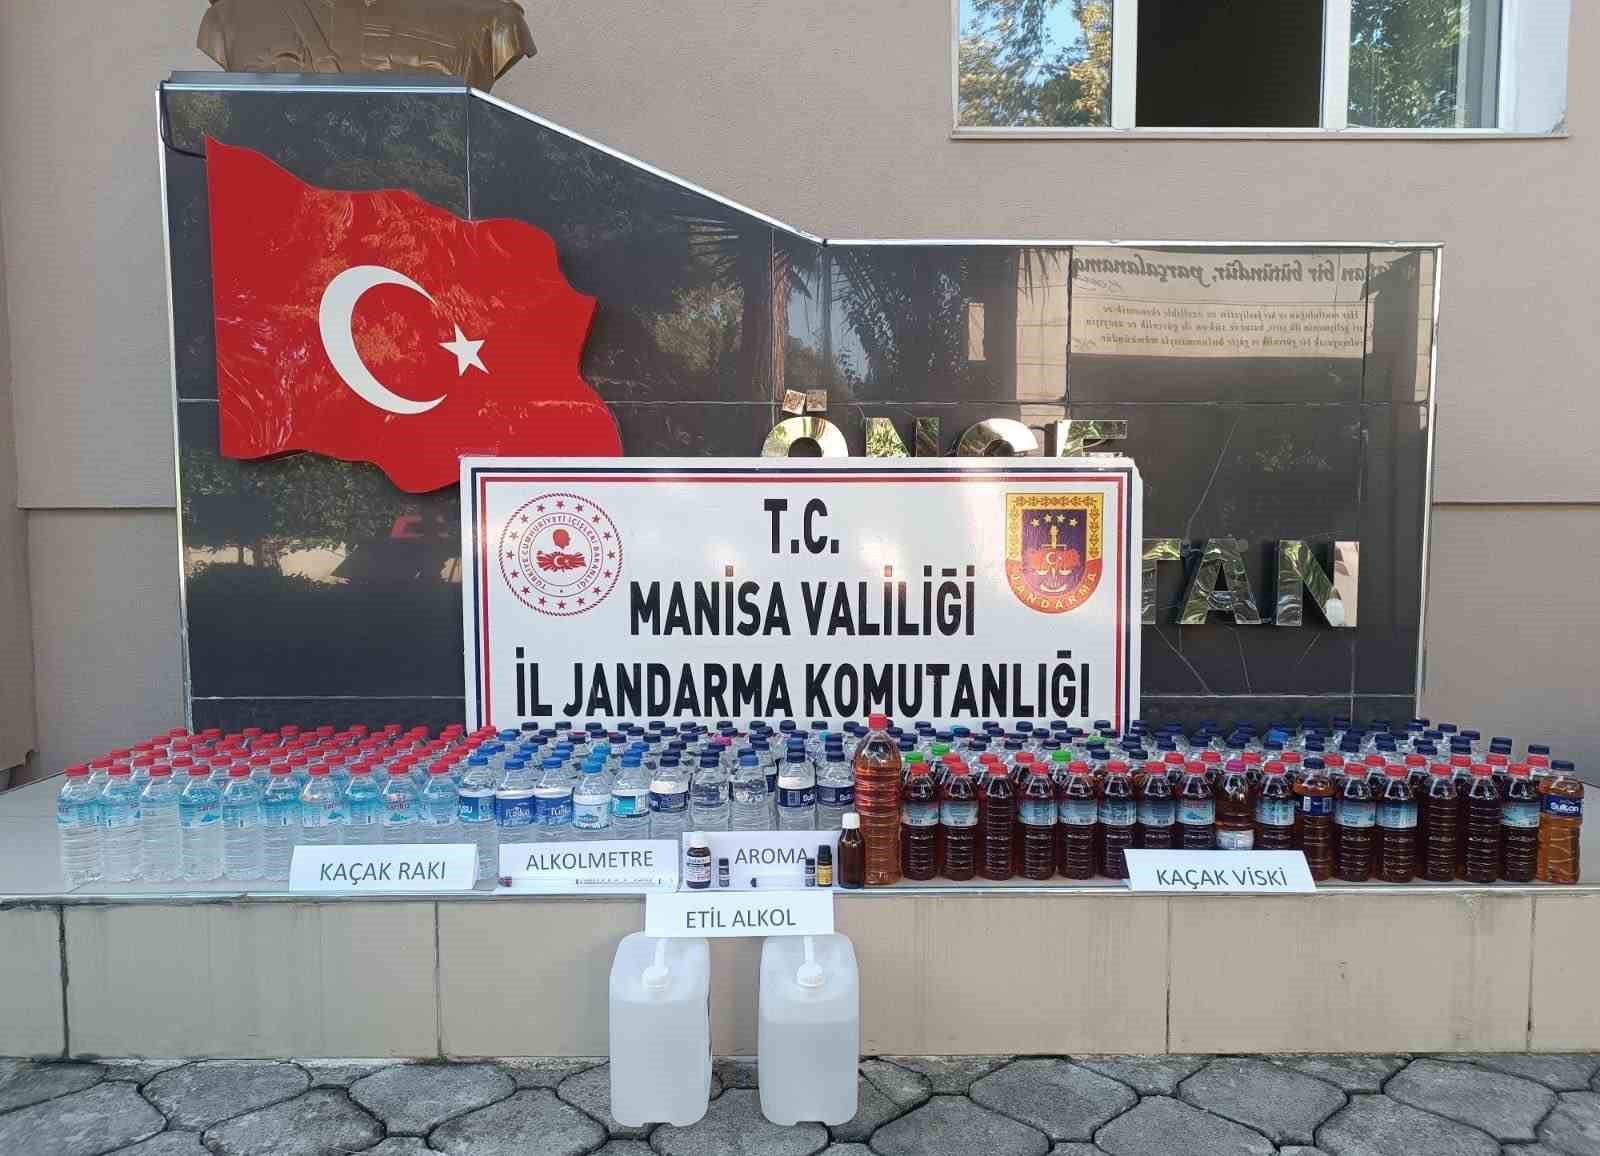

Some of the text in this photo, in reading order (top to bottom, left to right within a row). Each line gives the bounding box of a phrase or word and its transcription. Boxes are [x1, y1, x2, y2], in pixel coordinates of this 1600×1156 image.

[764, 498, 840, 555] T.C.
[631, 565, 975, 637] MANİSA VALİLİĞİ
[516, 647, 1090, 718] İL JANDARMA KOMUTANLIĞI
[526, 851, 654, 871] ALKOLMETRE
[735, 847, 807, 865] AROMA
[320, 862, 446, 885] KAÇAK RAKI
[1156, 866, 1288, 890] KAÇAK VİSKİ
[687, 906, 797, 929] ETİL ALKOL
